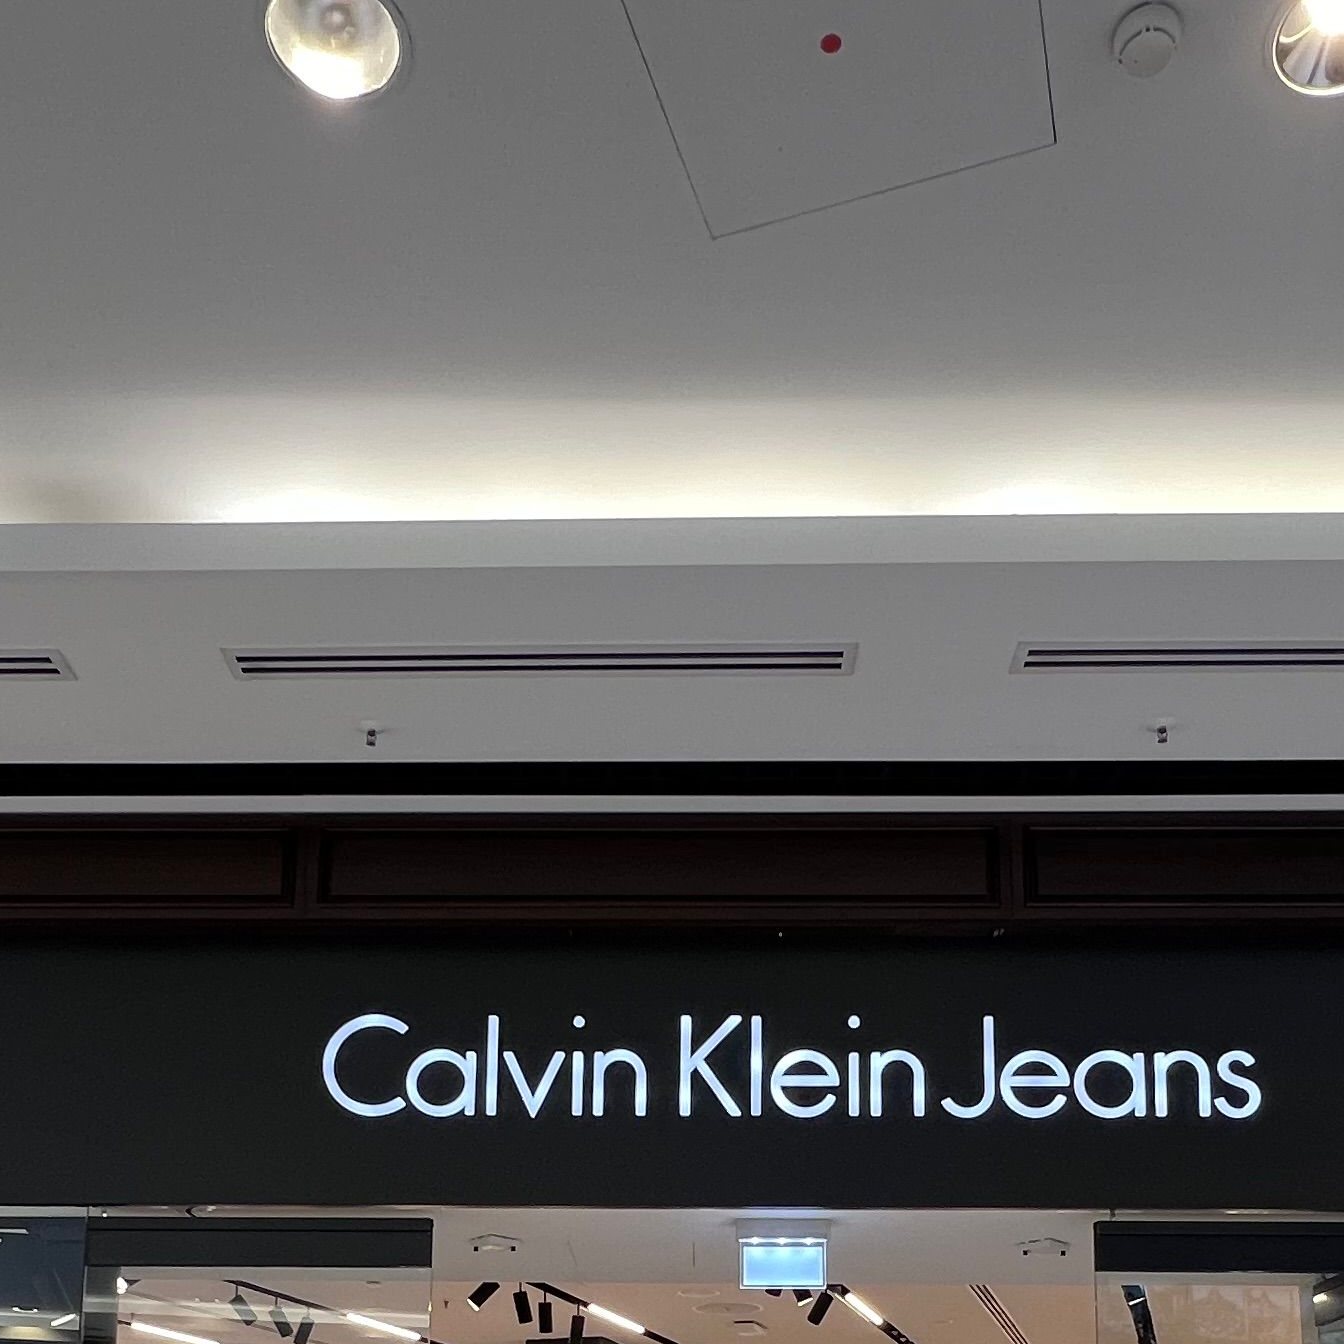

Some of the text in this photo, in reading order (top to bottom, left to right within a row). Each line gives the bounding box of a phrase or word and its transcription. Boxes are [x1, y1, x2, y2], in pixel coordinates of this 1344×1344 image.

[322, 1013, 1262, 1119] Calvin Klein Jeans
